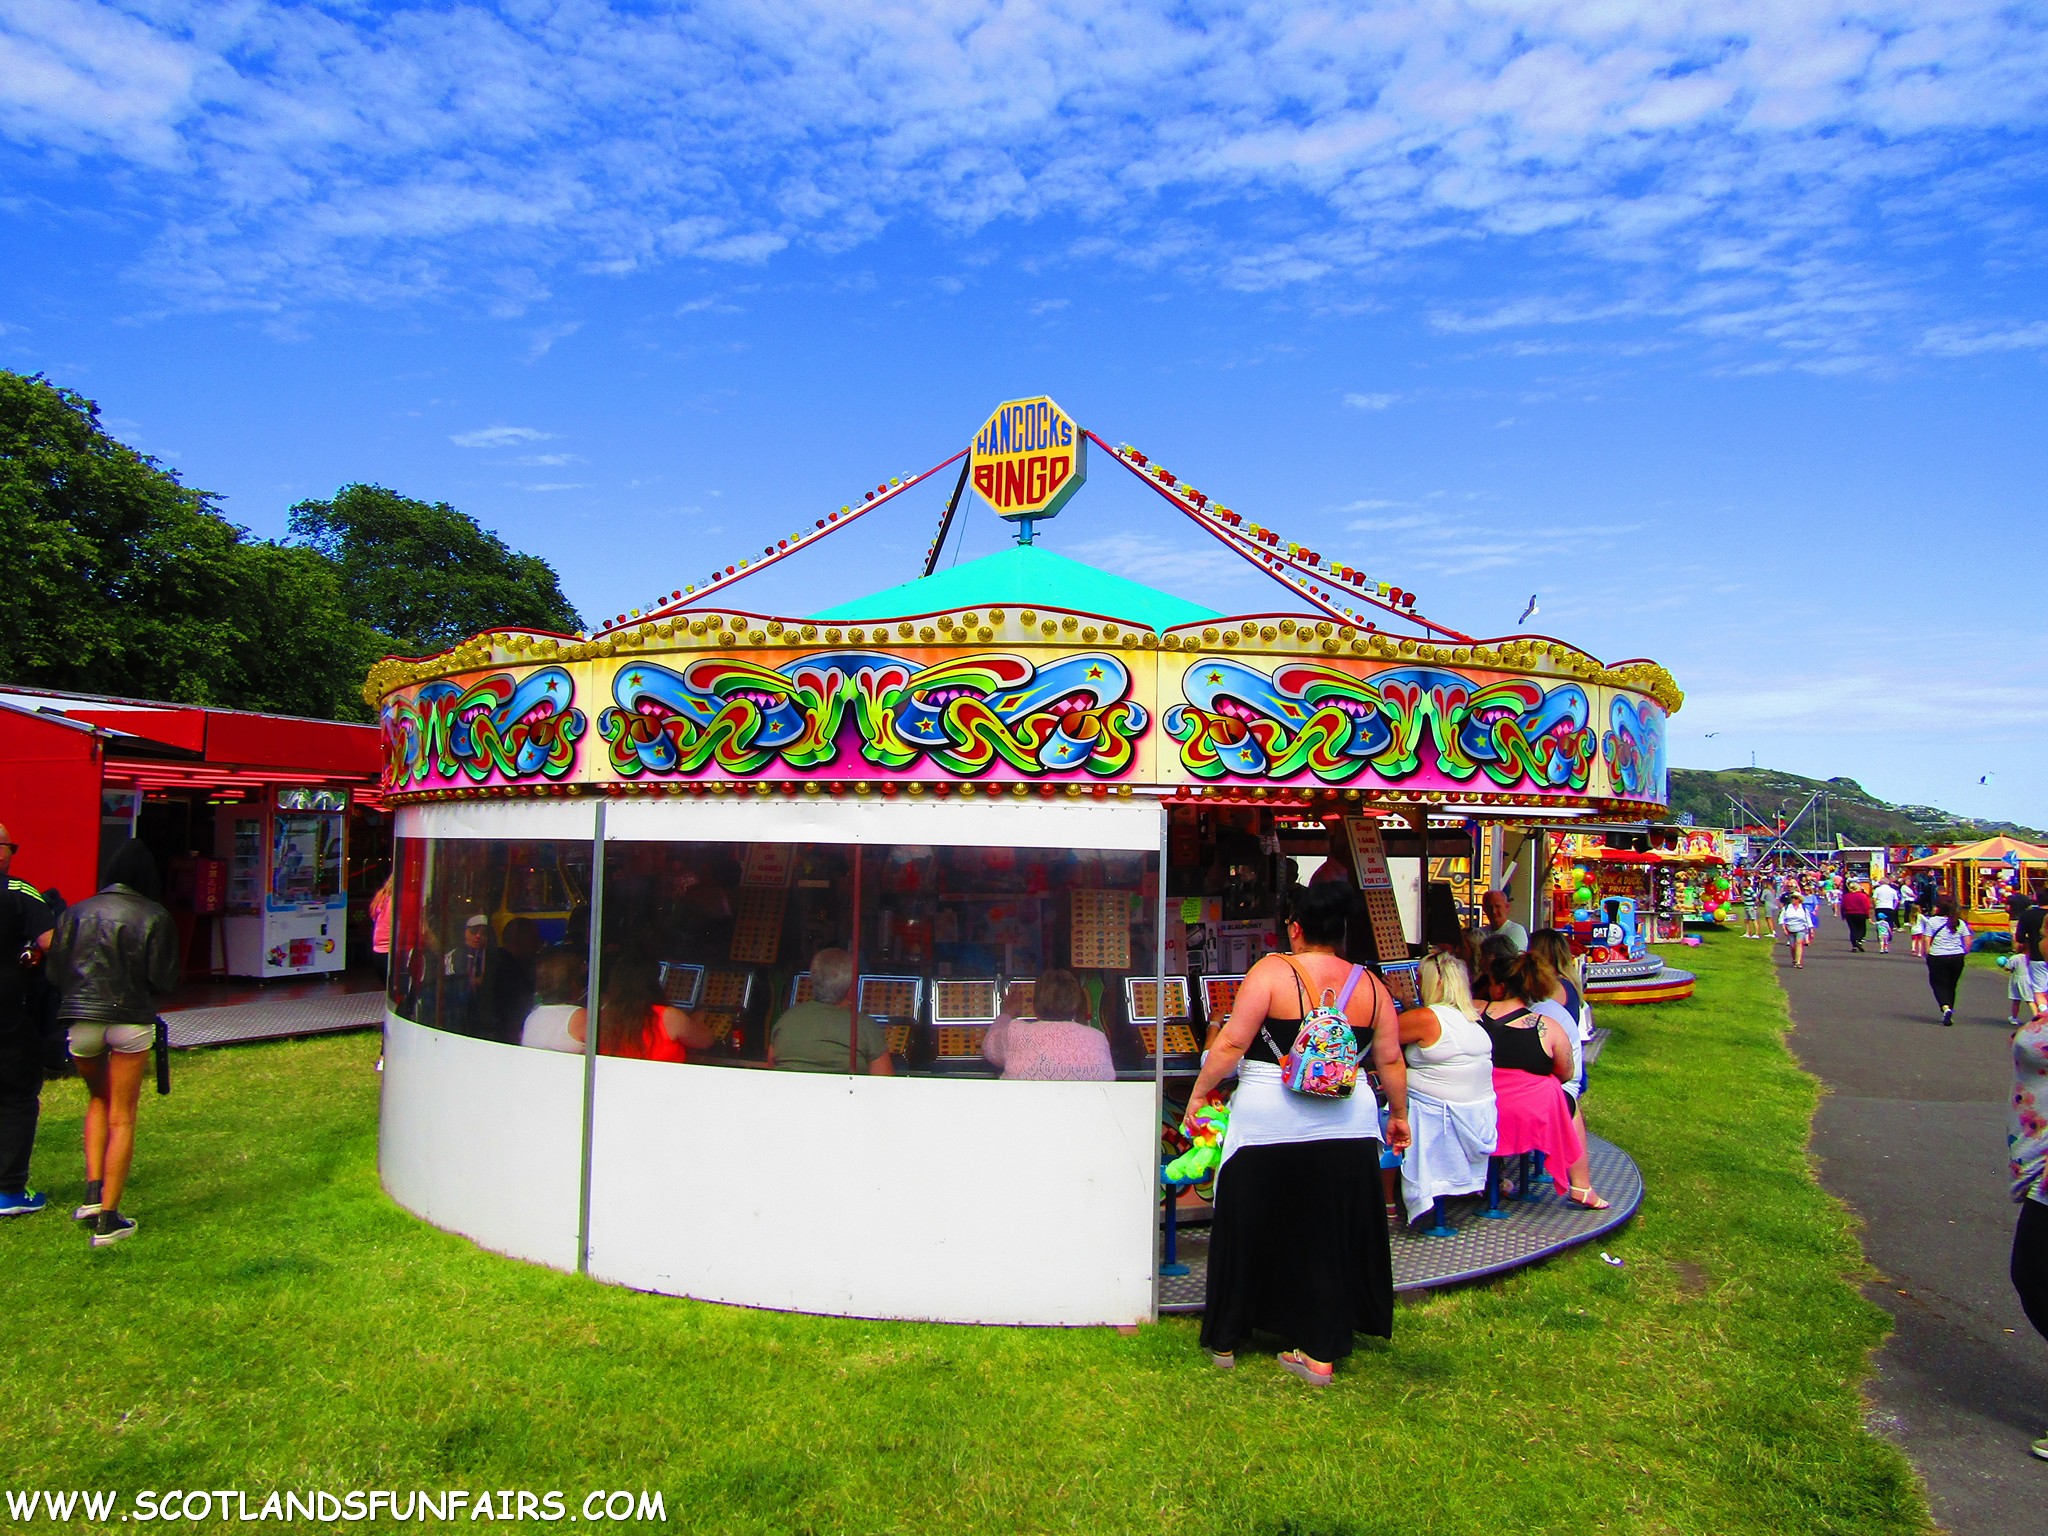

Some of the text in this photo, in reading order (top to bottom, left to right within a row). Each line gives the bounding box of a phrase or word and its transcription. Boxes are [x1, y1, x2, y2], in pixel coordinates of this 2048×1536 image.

[976, 401, 1072, 456] HANCOCKS
[974, 456, 1070, 507] BINGO
[1608, 885, 1631, 893] PRIZE
[1227, 922, 1262, 930] BLAUPUNKT
[1593, 927, 1608, 938] CAT
